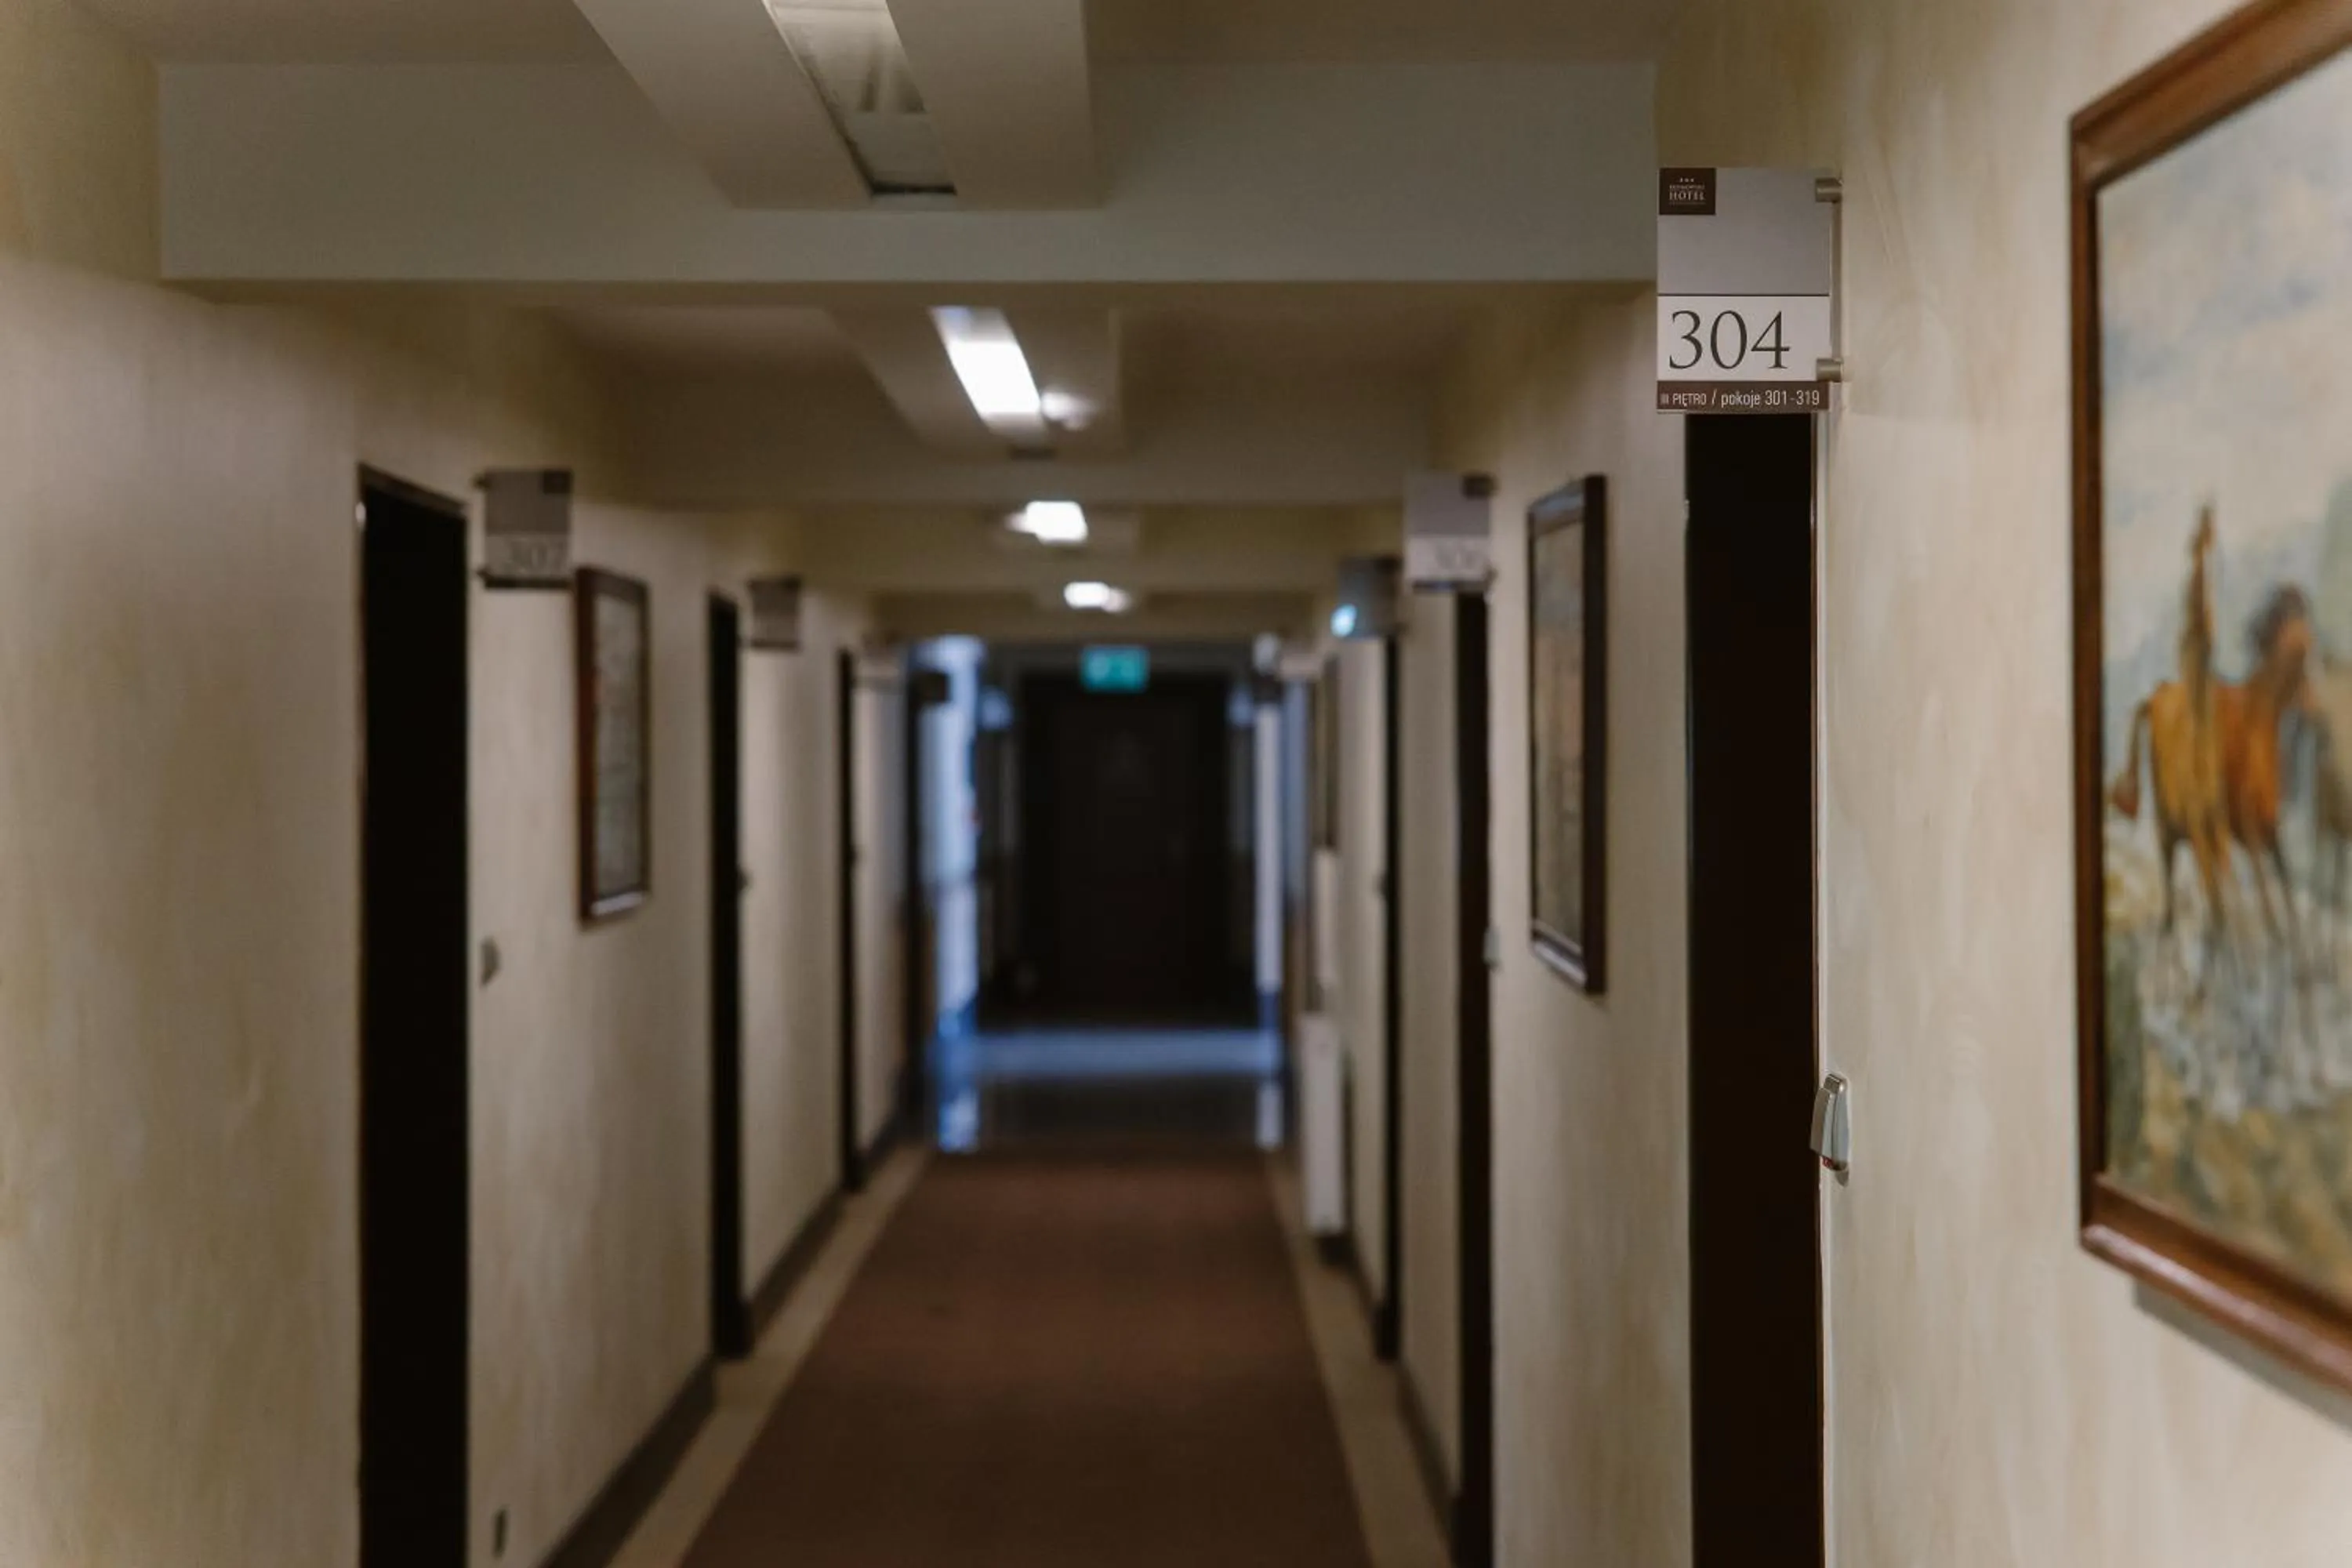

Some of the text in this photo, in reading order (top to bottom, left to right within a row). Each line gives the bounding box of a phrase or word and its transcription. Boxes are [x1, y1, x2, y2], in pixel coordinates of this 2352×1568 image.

[1669, 191, 1705, 201] HOTEL
[1669, 310, 1790, 369] 304
[1672, 393, 1707, 407] PIĘTRO
[1721, 390, 1760, 408] pokoje
[1765, 390, 1820, 406] 301-319
